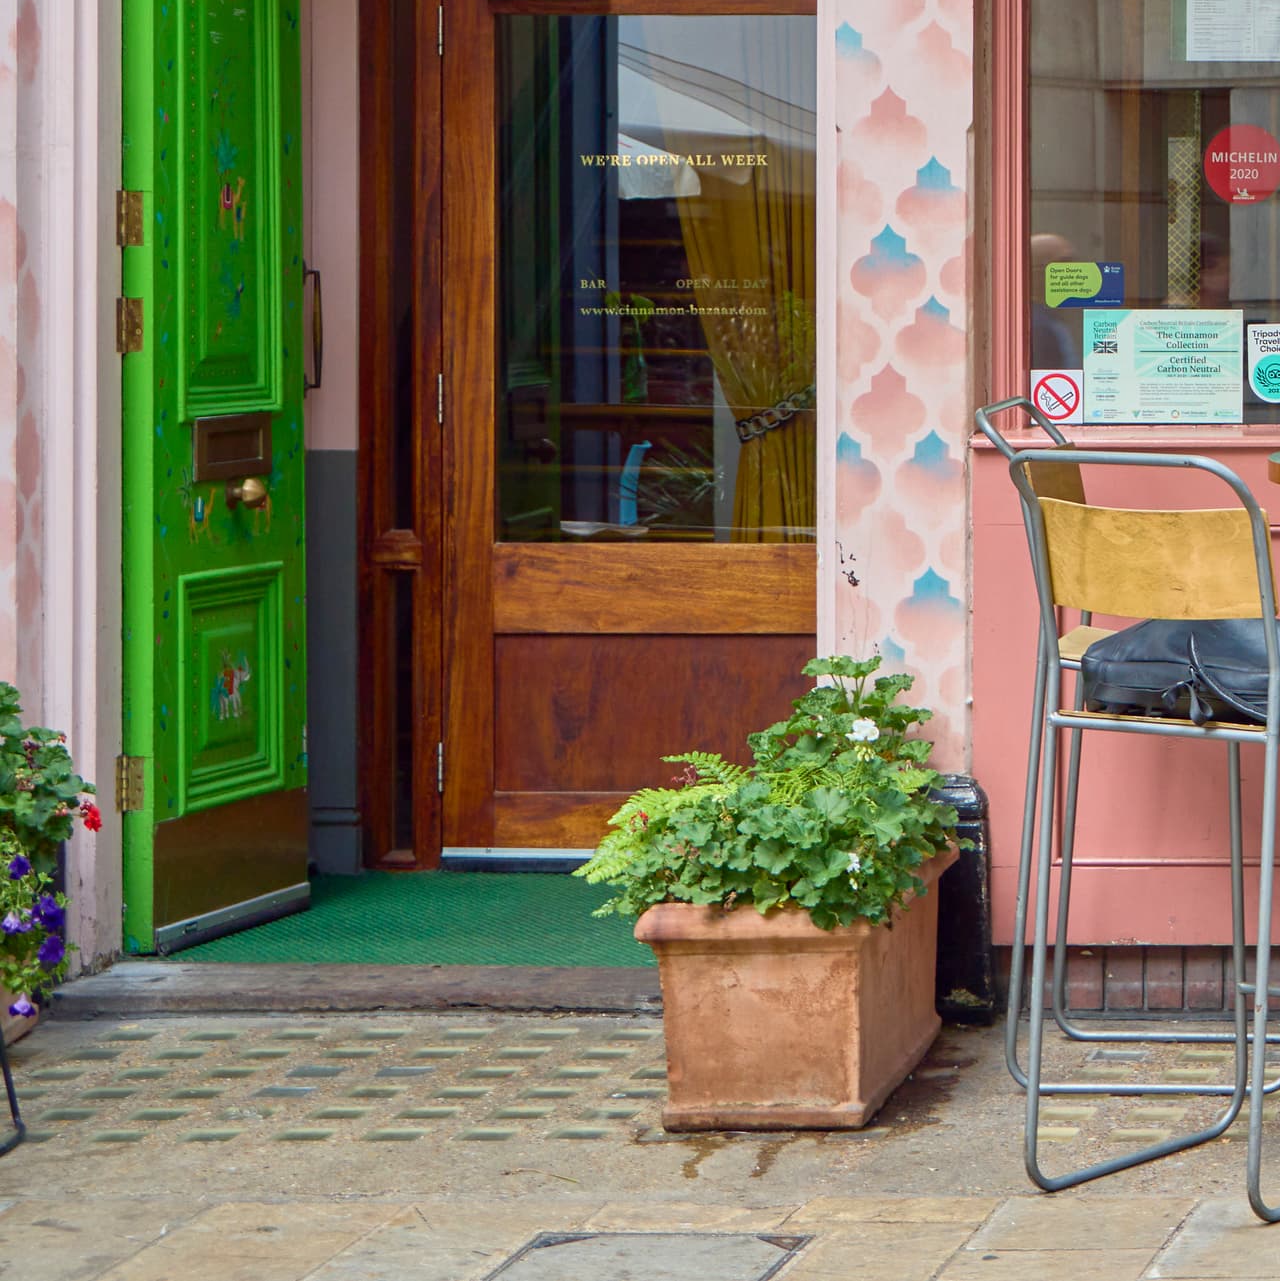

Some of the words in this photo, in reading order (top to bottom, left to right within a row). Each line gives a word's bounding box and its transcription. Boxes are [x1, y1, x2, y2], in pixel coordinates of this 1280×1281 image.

[580, 154, 632, 166] WE'RE
[636, 154, 680, 166] OPEN
[686, 154, 716, 166] ALL
[720, 154, 768, 166] WEEK
[1211, 151, 1278, 163] MICHELIN
[1229, 168, 1259, 180] 2020
[580, 279, 607, 289] BAR
[675, 279, 712, 289] OPEN
[714, 279, 739, 289] ALL
[743, 279, 769, 289] DAY
[580, 304, 768, 316] www.cinnamon-bazaar.com
[1157, 331, 1173, 339] The
[1175, 331, 1219, 339] Cinnamon
[1166, 341, 1209, 349] Collection
[1170, 356, 1207, 364] Certified
[1157, 365, 1188, 373] Carbon
[1190, 365, 1221, 373] Neutral
